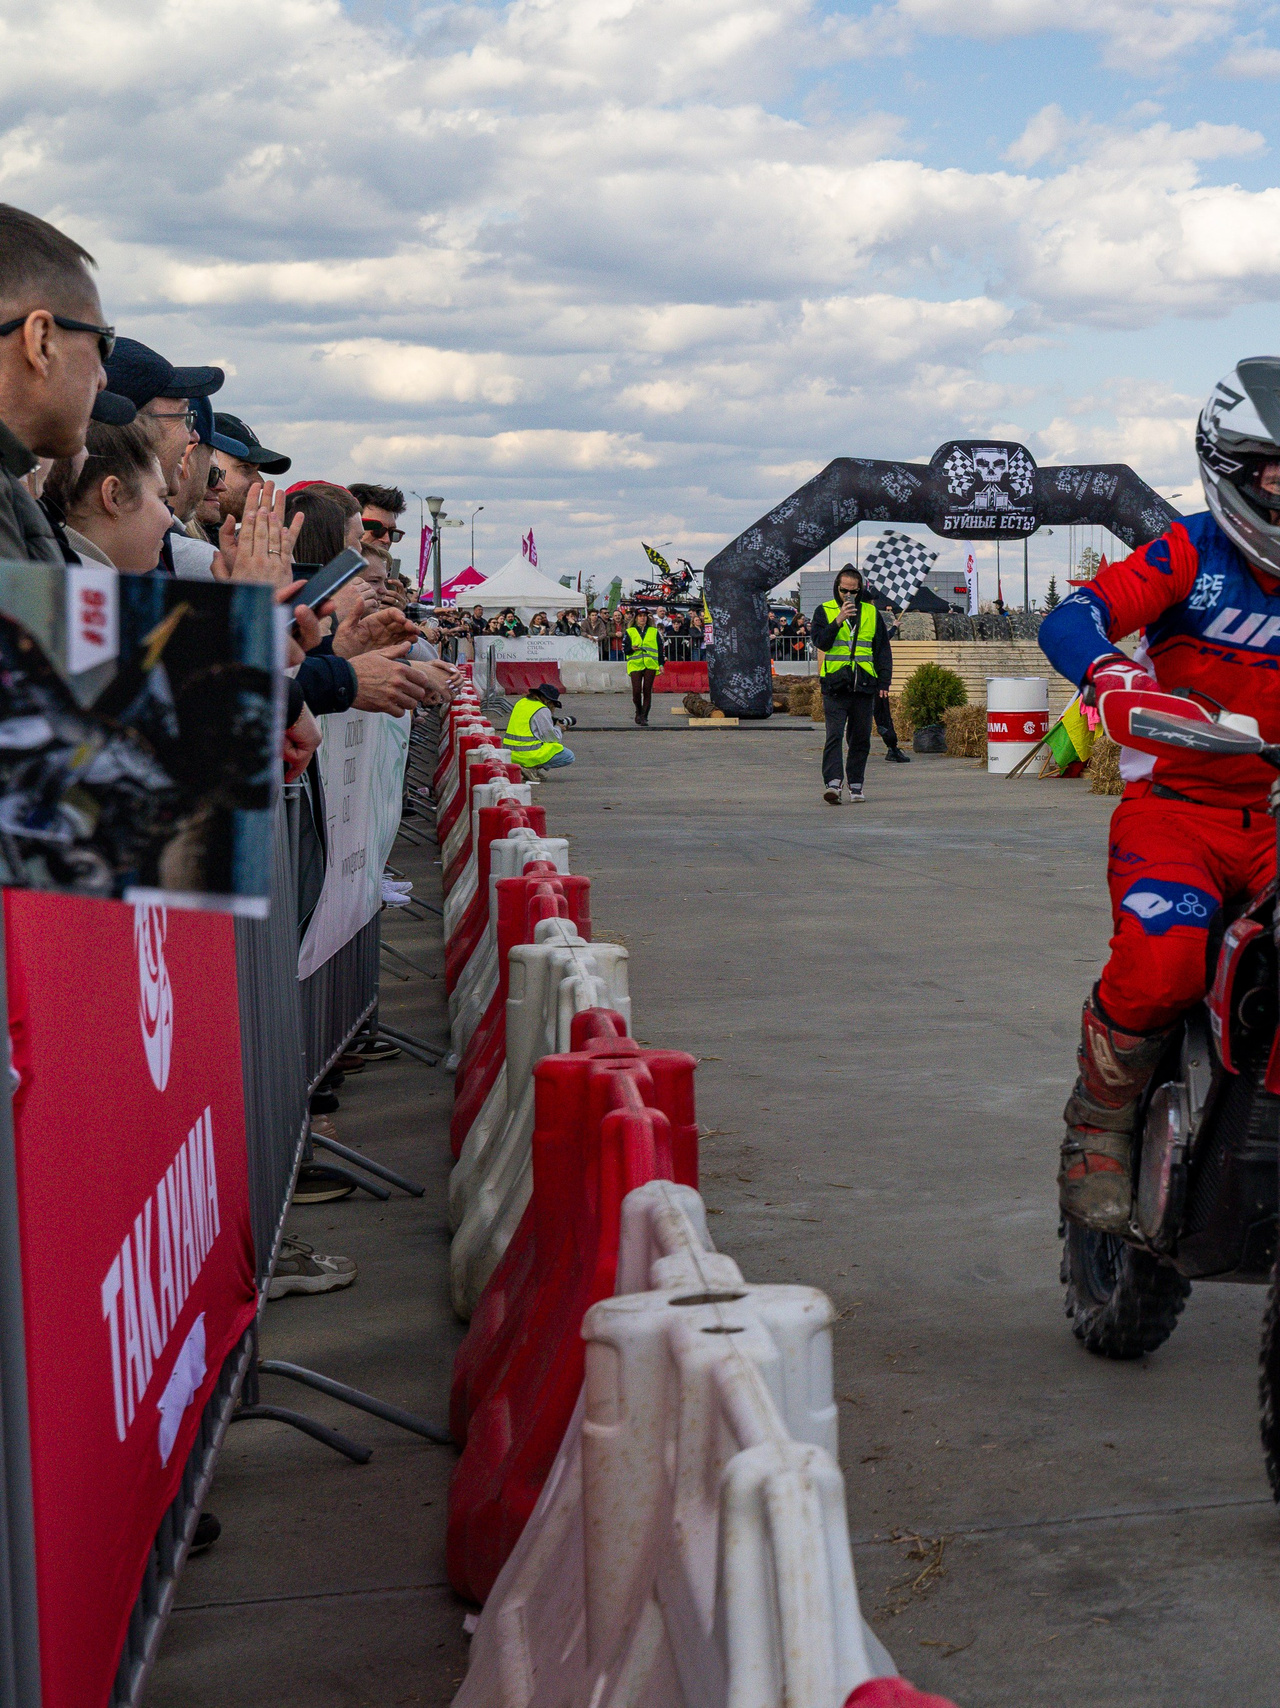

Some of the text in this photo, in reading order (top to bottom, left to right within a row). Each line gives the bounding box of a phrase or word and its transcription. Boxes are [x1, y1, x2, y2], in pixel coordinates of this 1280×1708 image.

[943, 513, 1036, 531] БУЙНЫЕ ЕСТЬ?
[481, 652, 517, 660] GDENS
[100, 1104, 221, 1443] TAKAYAMA
